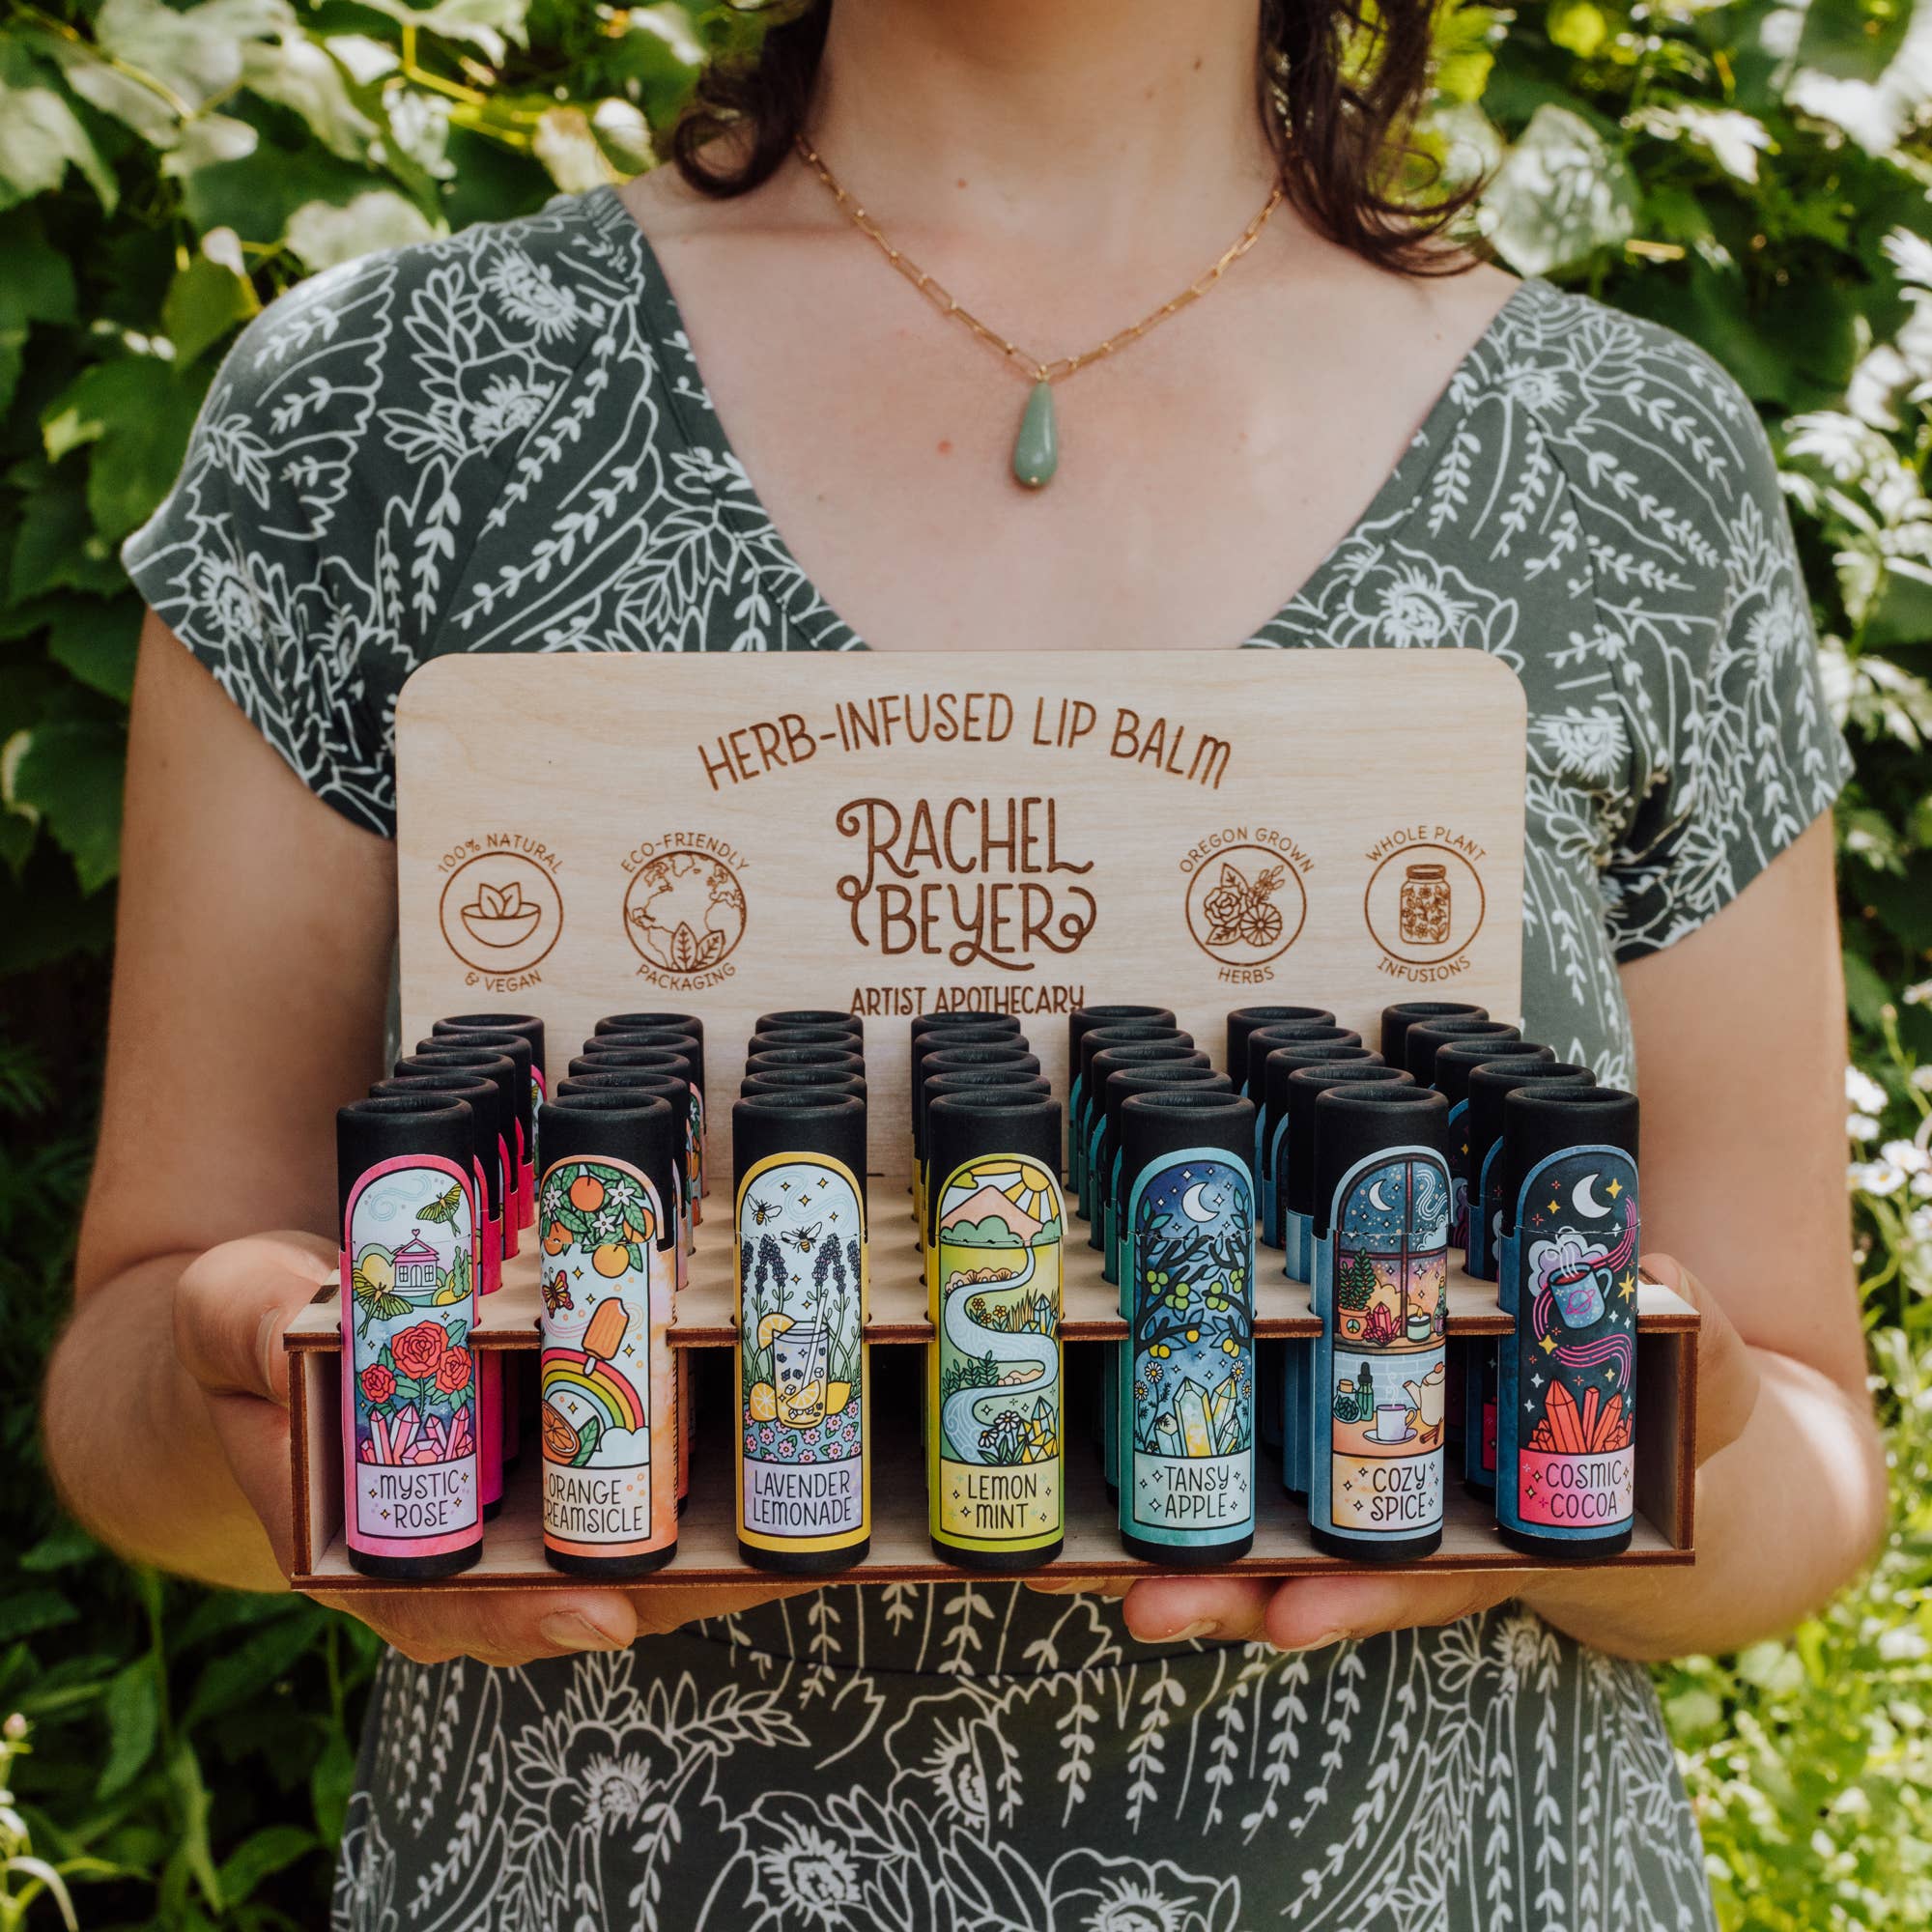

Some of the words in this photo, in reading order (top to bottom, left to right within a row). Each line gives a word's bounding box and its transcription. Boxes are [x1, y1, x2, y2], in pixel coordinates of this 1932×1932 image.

[697, 693, 1013, 791] HERB-INFUSED
[1032, 696, 1097, 749] LIP
[1109, 708, 1232, 789] BALM
[620, 832, 751, 872] ECO-FRIENDLY
[837, 797, 1094, 878] RACHEL
[1179, 826, 1248, 874] OREGON
[1255, 827, 1315, 873] GROWN
[1365, 826, 1428, 866] WHOLE
[1434, 827, 1487, 863] PLANT
[438, 840, 481, 873] 100%
[486, 833, 563, 875] NATURAL
[837, 883, 1096, 971] BEYER
[465, 972, 479, 986] &
[484, 969, 543, 993] VEGAN
[636, 962, 737, 992] PACKAGING
[1217, 966, 1275, 984] HERBS
[1377, 954, 1471, 983] INFUSIONS
[850, 987, 927, 1015] ARTIST
[933, 985, 1084, 1015] APOTHECARY
[379, 1469, 460, 1500] MYSTIC
[549, 1472, 621, 1505] ORANGE
[753, 1469, 851, 1498] LAVENDER
[968, 1472, 1037, 1500] LEMON
[1162, 1463, 1231, 1492] TANSY
[1372, 1463, 1427, 1492] COZY
[1546, 1459, 1622, 1490] COSMIC
[394, 1500, 448, 1529] ROSE
[753, 1495, 852, 1526] LEMONADE
[976, 1502, 1029, 1529] MINT
[1165, 1492, 1227, 1520] APPLE
[1370, 1492, 1427, 1521] SPICE
[1549, 1491, 1618, 1520] COCOA
